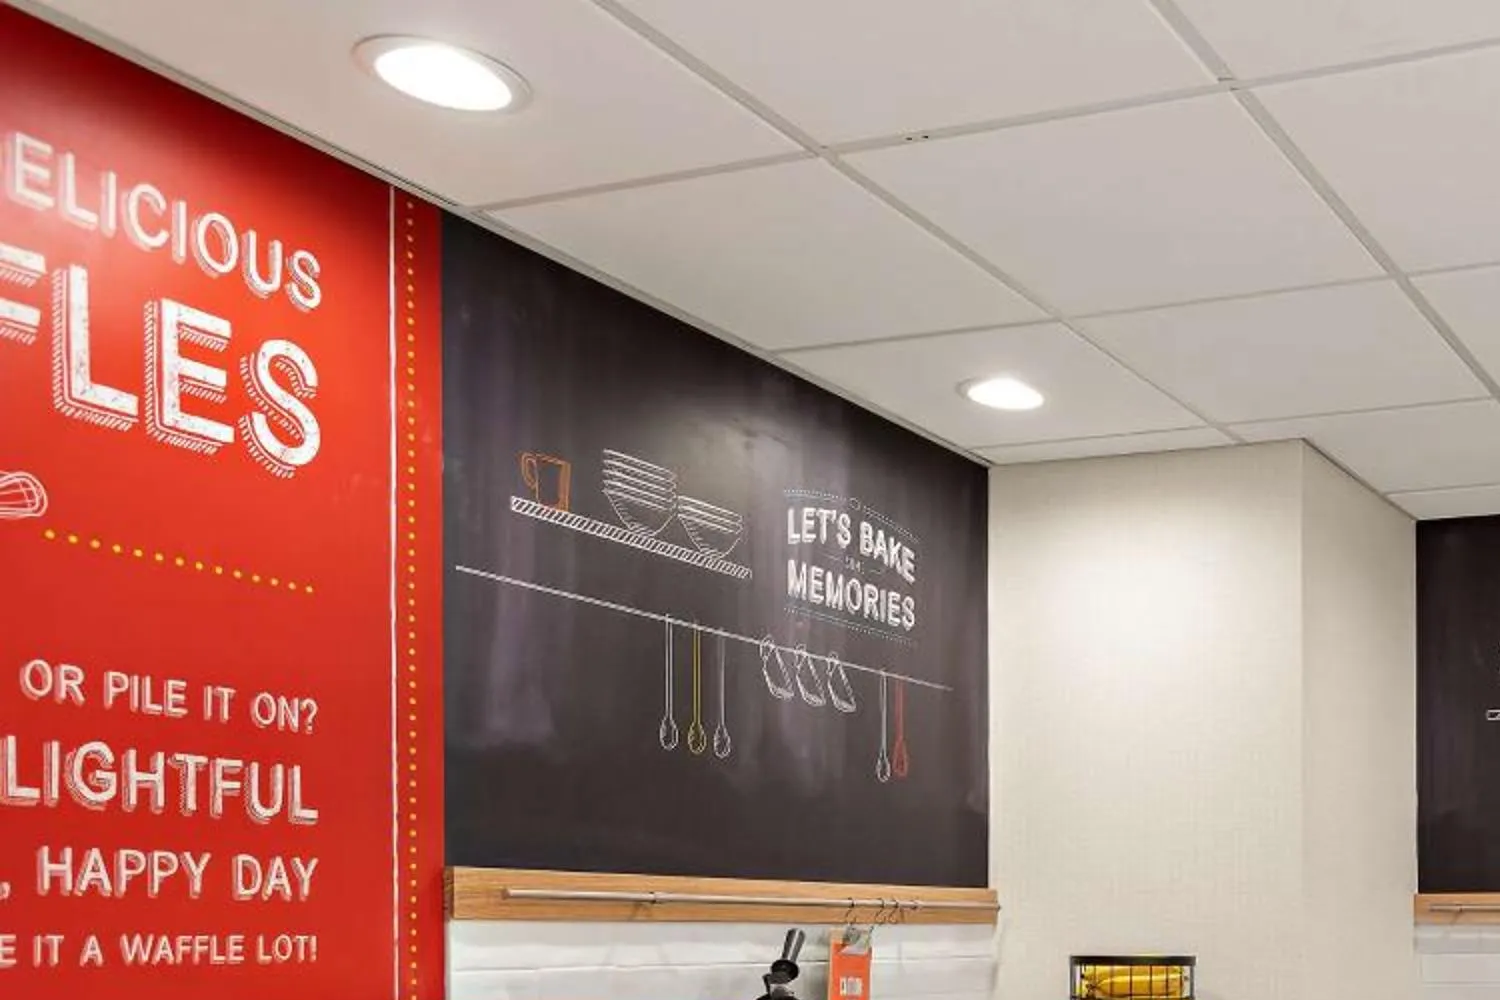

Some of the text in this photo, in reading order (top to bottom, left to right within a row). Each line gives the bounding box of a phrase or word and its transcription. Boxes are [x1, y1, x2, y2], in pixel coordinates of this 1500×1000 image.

[8, 131, 322, 312] ELICIOUS
[787, 507, 916, 583] LET'S BAKE
[787, 559, 916, 632] MEMORIES
[19, 659, 318, 734] OR PILE IT ON?
[0, 735, 319, 825] LIGHTFUL
[37, 845, 319, 900] HAPPY DAY
[33, 933, 64, 968] IT
[79, 934, 104, 967] A
[120, 933, 245, 966] WAFFLE
[257, 934, 318, 963] LOT!
